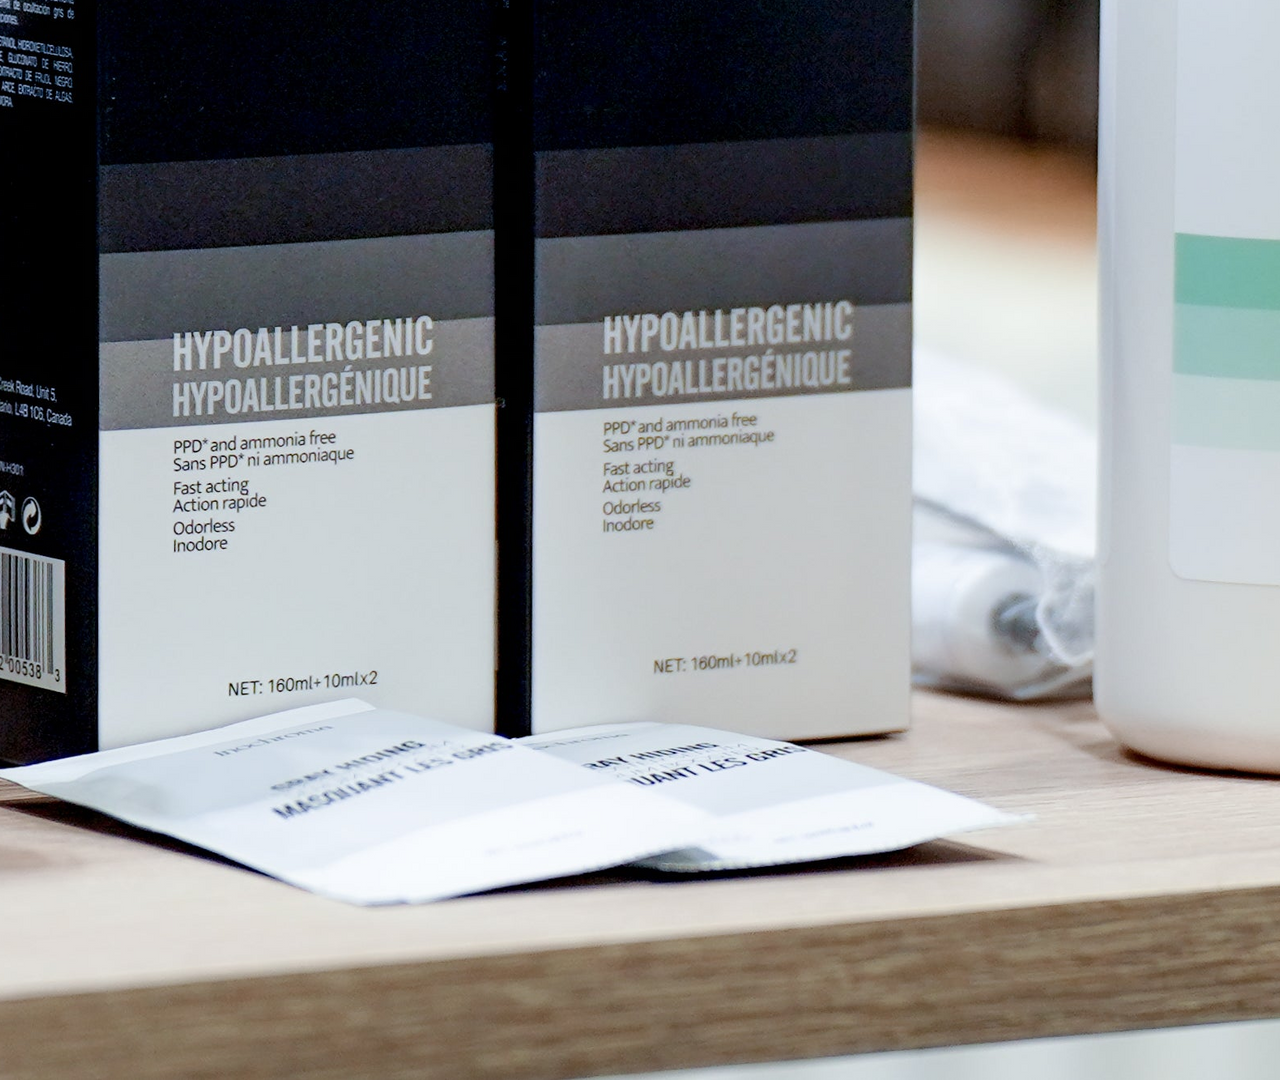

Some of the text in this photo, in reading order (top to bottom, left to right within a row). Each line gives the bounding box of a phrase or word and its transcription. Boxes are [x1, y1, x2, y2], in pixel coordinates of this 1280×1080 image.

[603, 300, 853, 354] HYPOALLERGENIC
[173, 315, 433, 371] HYPOALLERGENIC
[603, 349, 851, 399] HYPOALLERGÉNIQUE
[35, 384, 49, 401] Unit
[172, 365, 432, 417] HYPOALLERGÉNIQUE
[14, 401, 28, 417] L4B
[46, 408, 72, 426] Canada
[638, 418, 662, 433] and
[666, 413, 728, 431] ammonia
[732, 413, 757, 428] free
[211, 435, 236, 452] and
[240, 431, 305, 450] ammonia
[310, 430, 336, 446] free
[603, 438, 634, 453] Sans
[672, 435, 685, 448] ni
[688, 429, 775, 448] ammoniaque
[173, 457, 206, 471] Sans
[247, 453, 260, 466] ni
[264, 447, 355, 466] ammoniaque
[603, 459, 674, 477] Fast acting
[173, 478, 249, 496] Fast acting
[603, 475, 691, 493] Action rapide
[173, 494, 267, 513] Action rapide
[603, 499, 661, 515] Odorless
[173, 519, 235, 535] Odorless
[603, 517, 654, 533] Inodore
[173, 537, 228, 553] Inodore
[654, 659, 686, 674] NET:
[228, 681, 263, 696] NET:
[214, 725, 333, 758] Inochroma
[630, 742, 719, 761] HIDING
[335, 739, 426, 771] HIDING
[699, 758, 748, 772] LES
[746, 746, 807, 762] GRIS
[272, 770, 404, 820] MASQUANT
[405, 757, 453, 774] LES
[452, 741, 514, 761] GRIS
